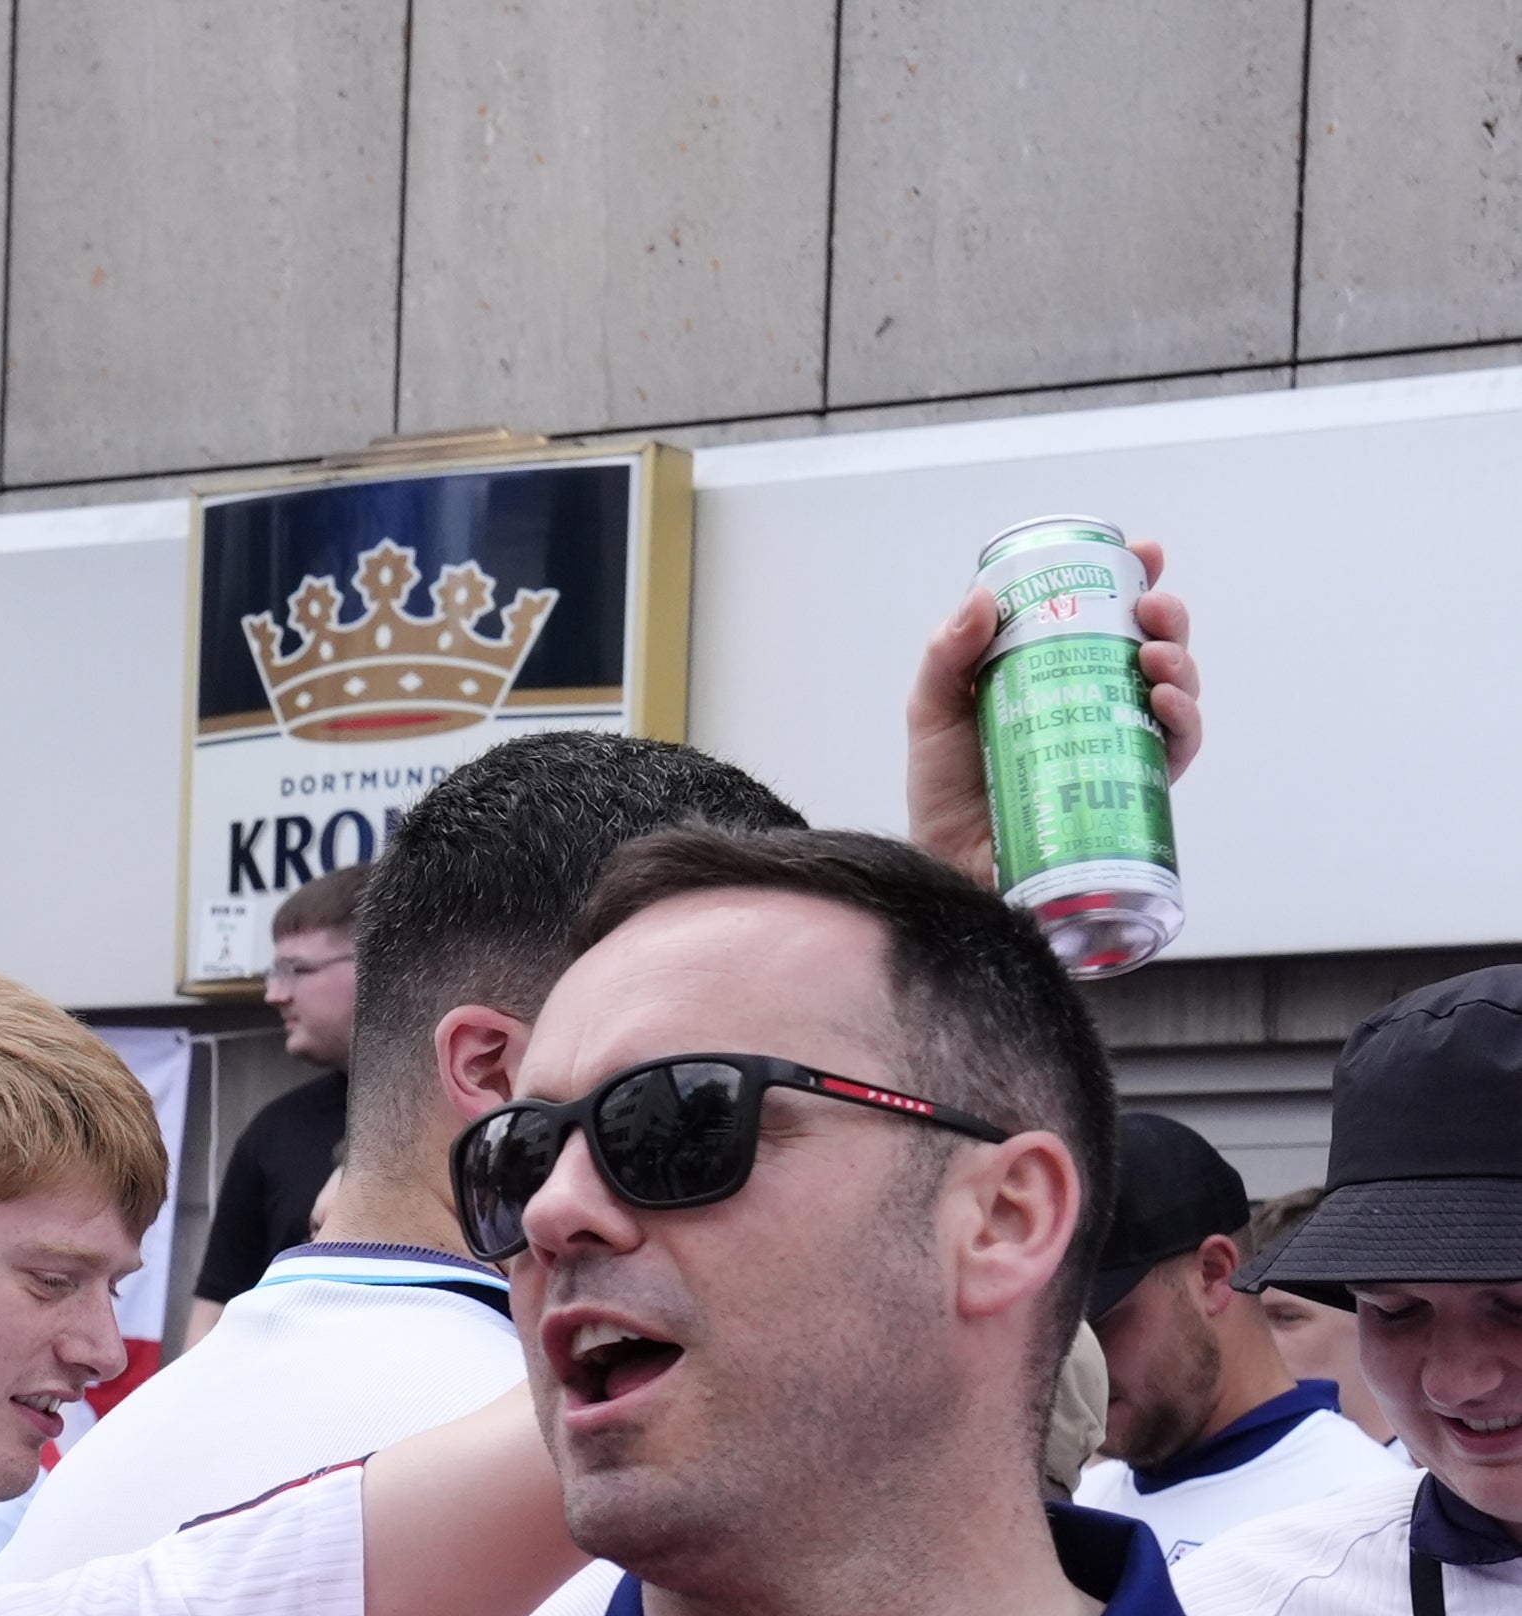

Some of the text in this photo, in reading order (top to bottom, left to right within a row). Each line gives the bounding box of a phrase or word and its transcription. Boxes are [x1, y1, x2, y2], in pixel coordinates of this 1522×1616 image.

[1008, 683, 1102, 721] HÖMMA
[1012, 705, 1112, 741] PILSKEN
[1028, 738, 1113, 766] TINNEF
[281, 766, 448, 797] DORTMUND
[867, 1089, 927, 1112] PRADA
